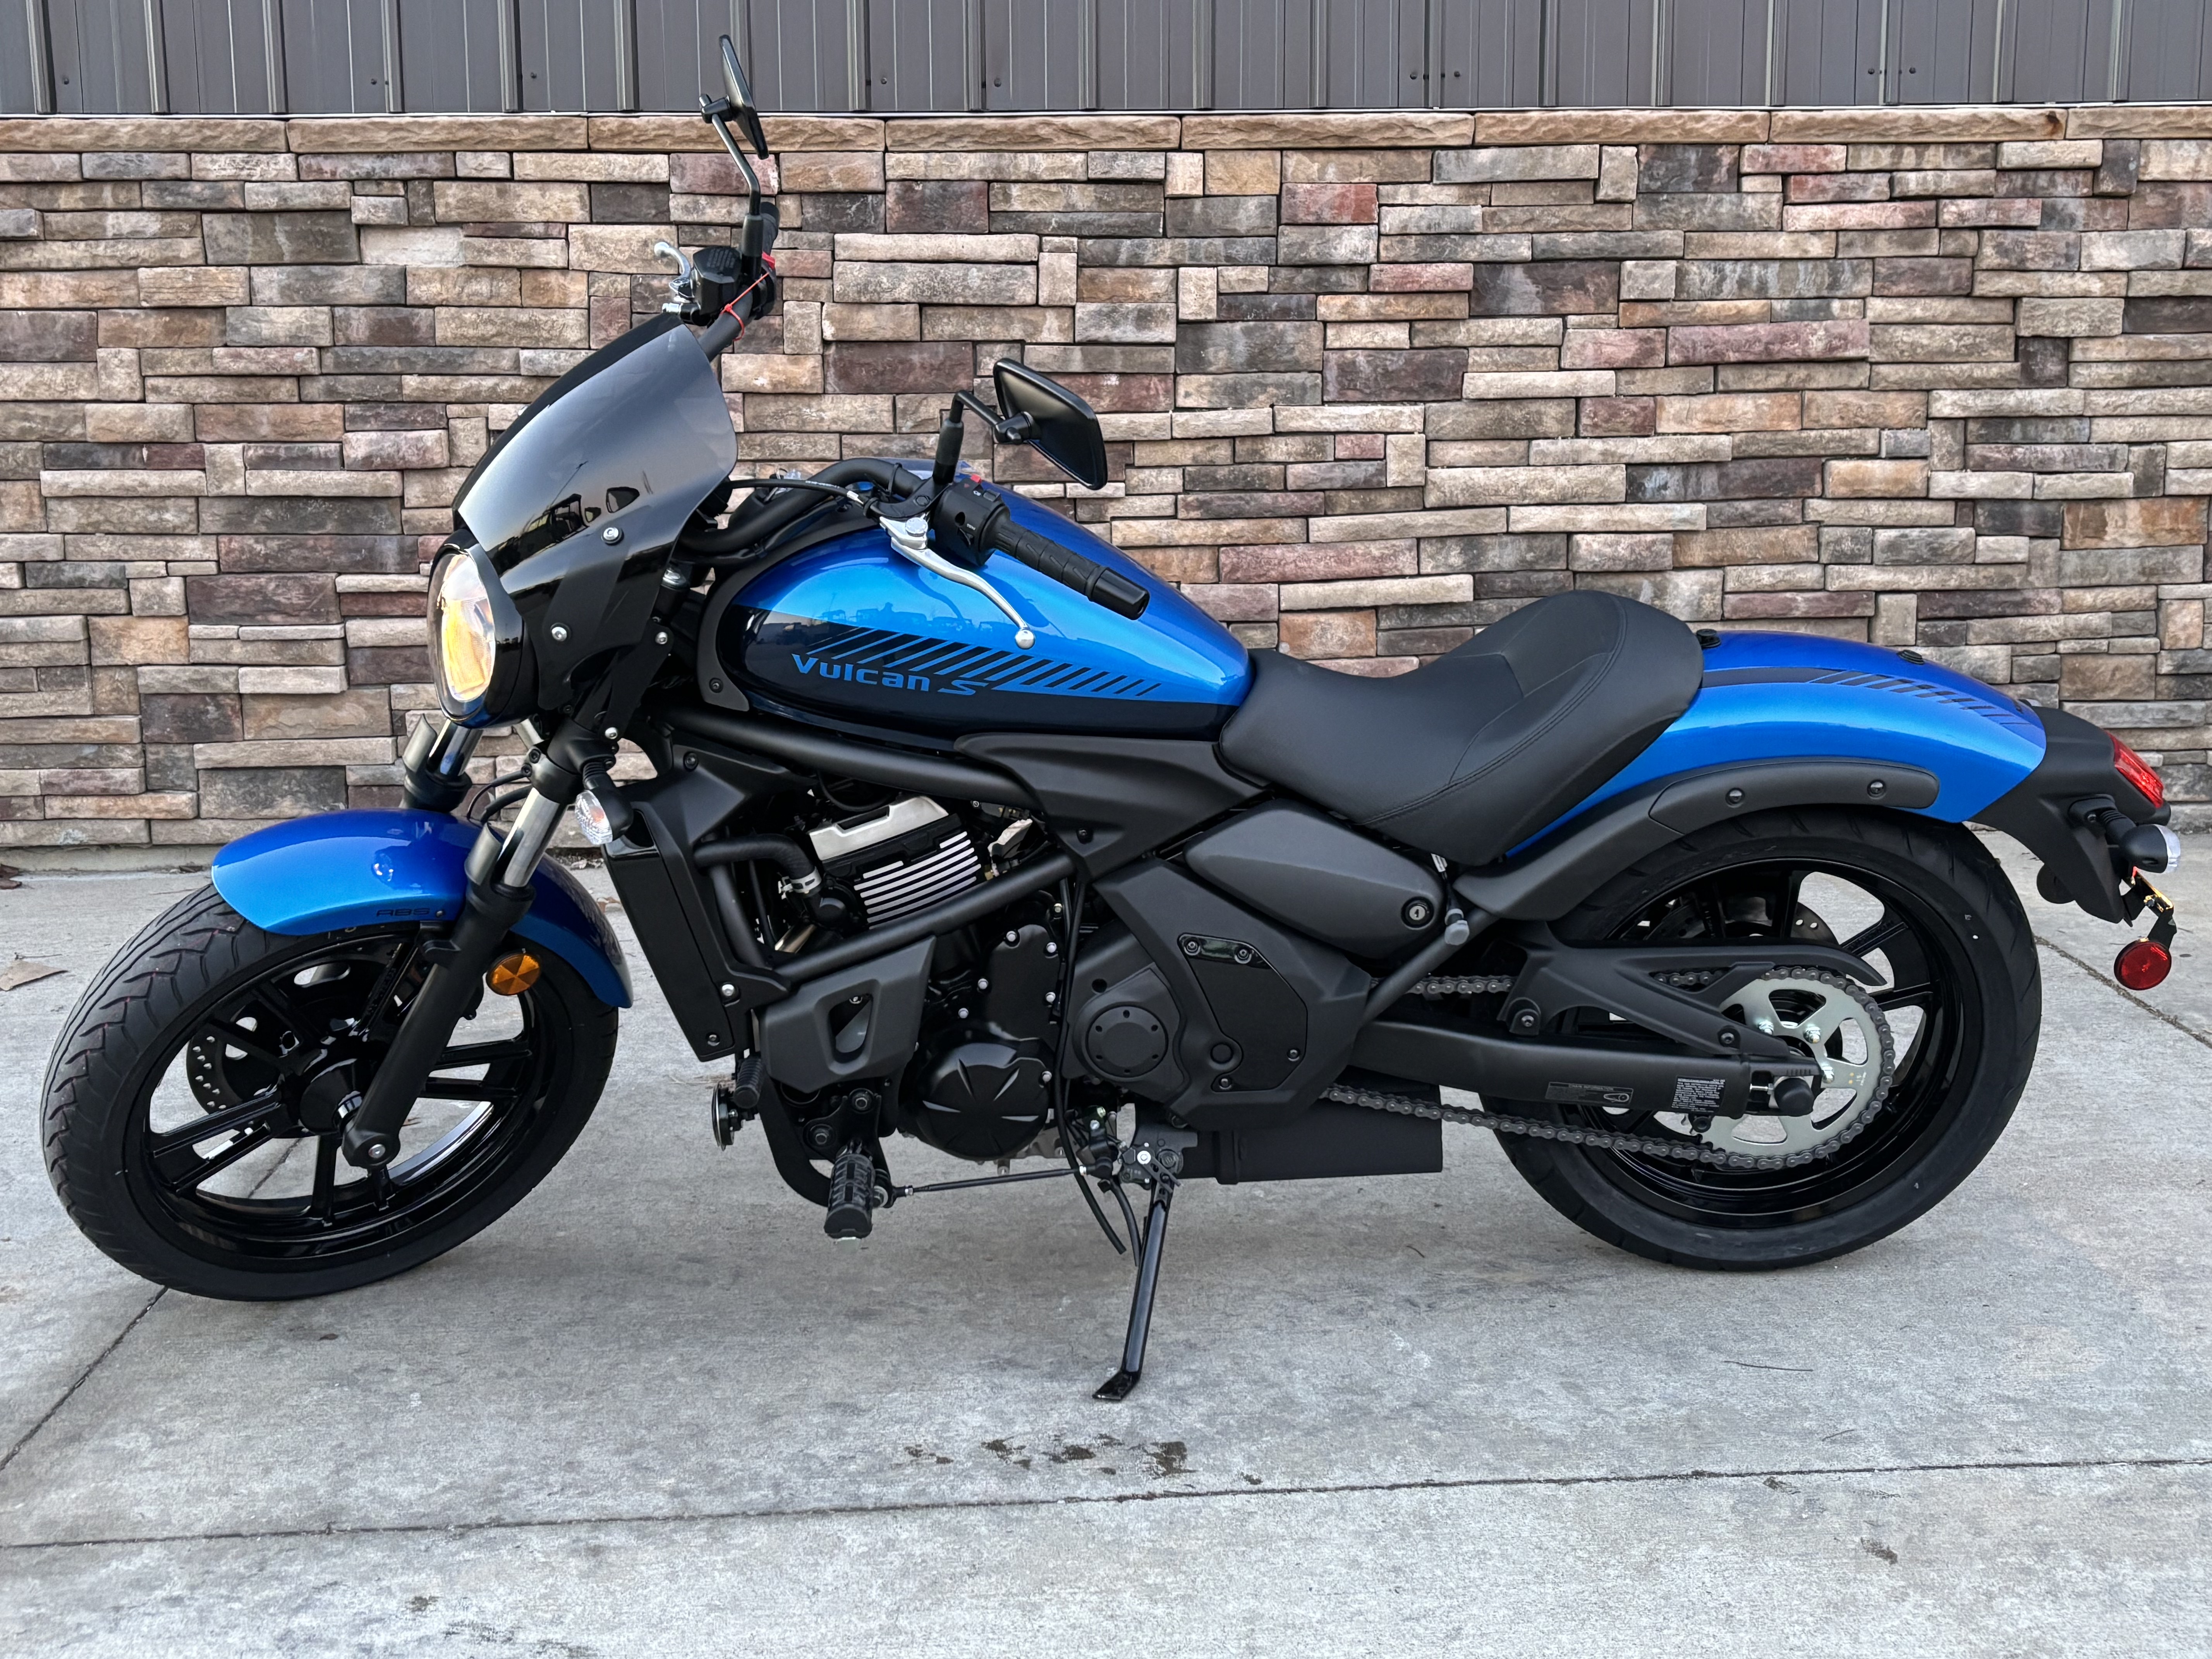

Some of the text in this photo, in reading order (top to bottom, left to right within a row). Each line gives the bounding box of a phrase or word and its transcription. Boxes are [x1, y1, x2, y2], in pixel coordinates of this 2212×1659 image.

[792, 653, 989, 696] Vulcan S
[376, 907, 430, 917] ABS
